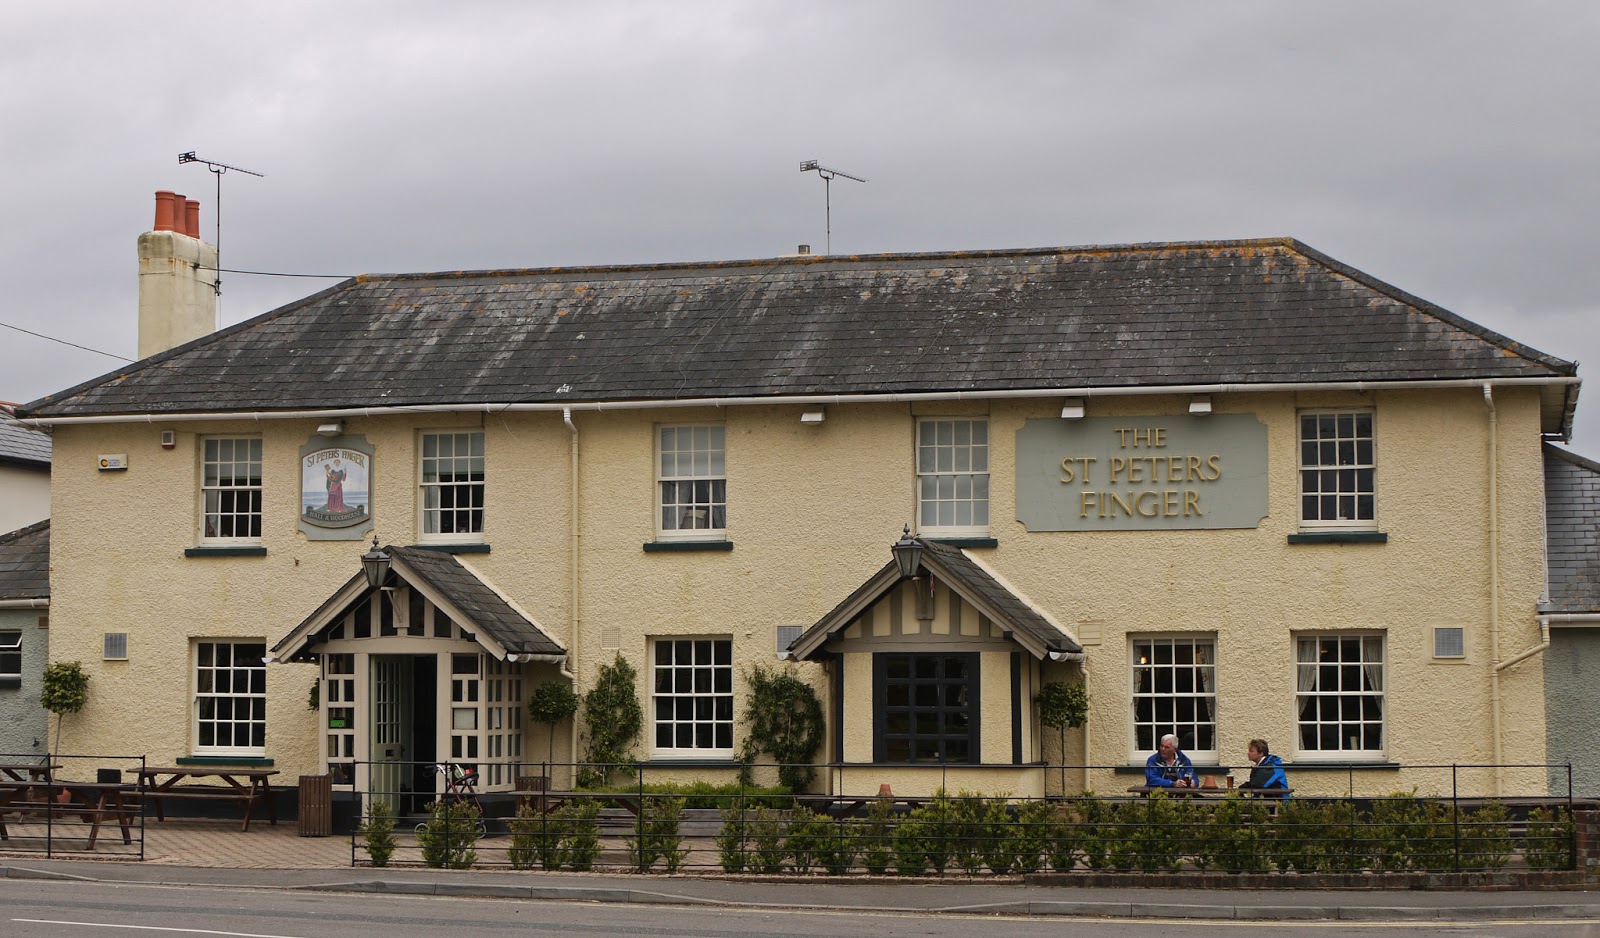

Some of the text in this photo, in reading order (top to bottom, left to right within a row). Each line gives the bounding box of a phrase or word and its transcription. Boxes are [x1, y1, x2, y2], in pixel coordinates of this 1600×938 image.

[1115, 428, 1167, 449] THE
[307, 454, 315, 468] ST
[1060, 454, 1221, 483] ST PETERS
[1080, 490, 1203, 518] FINGER
